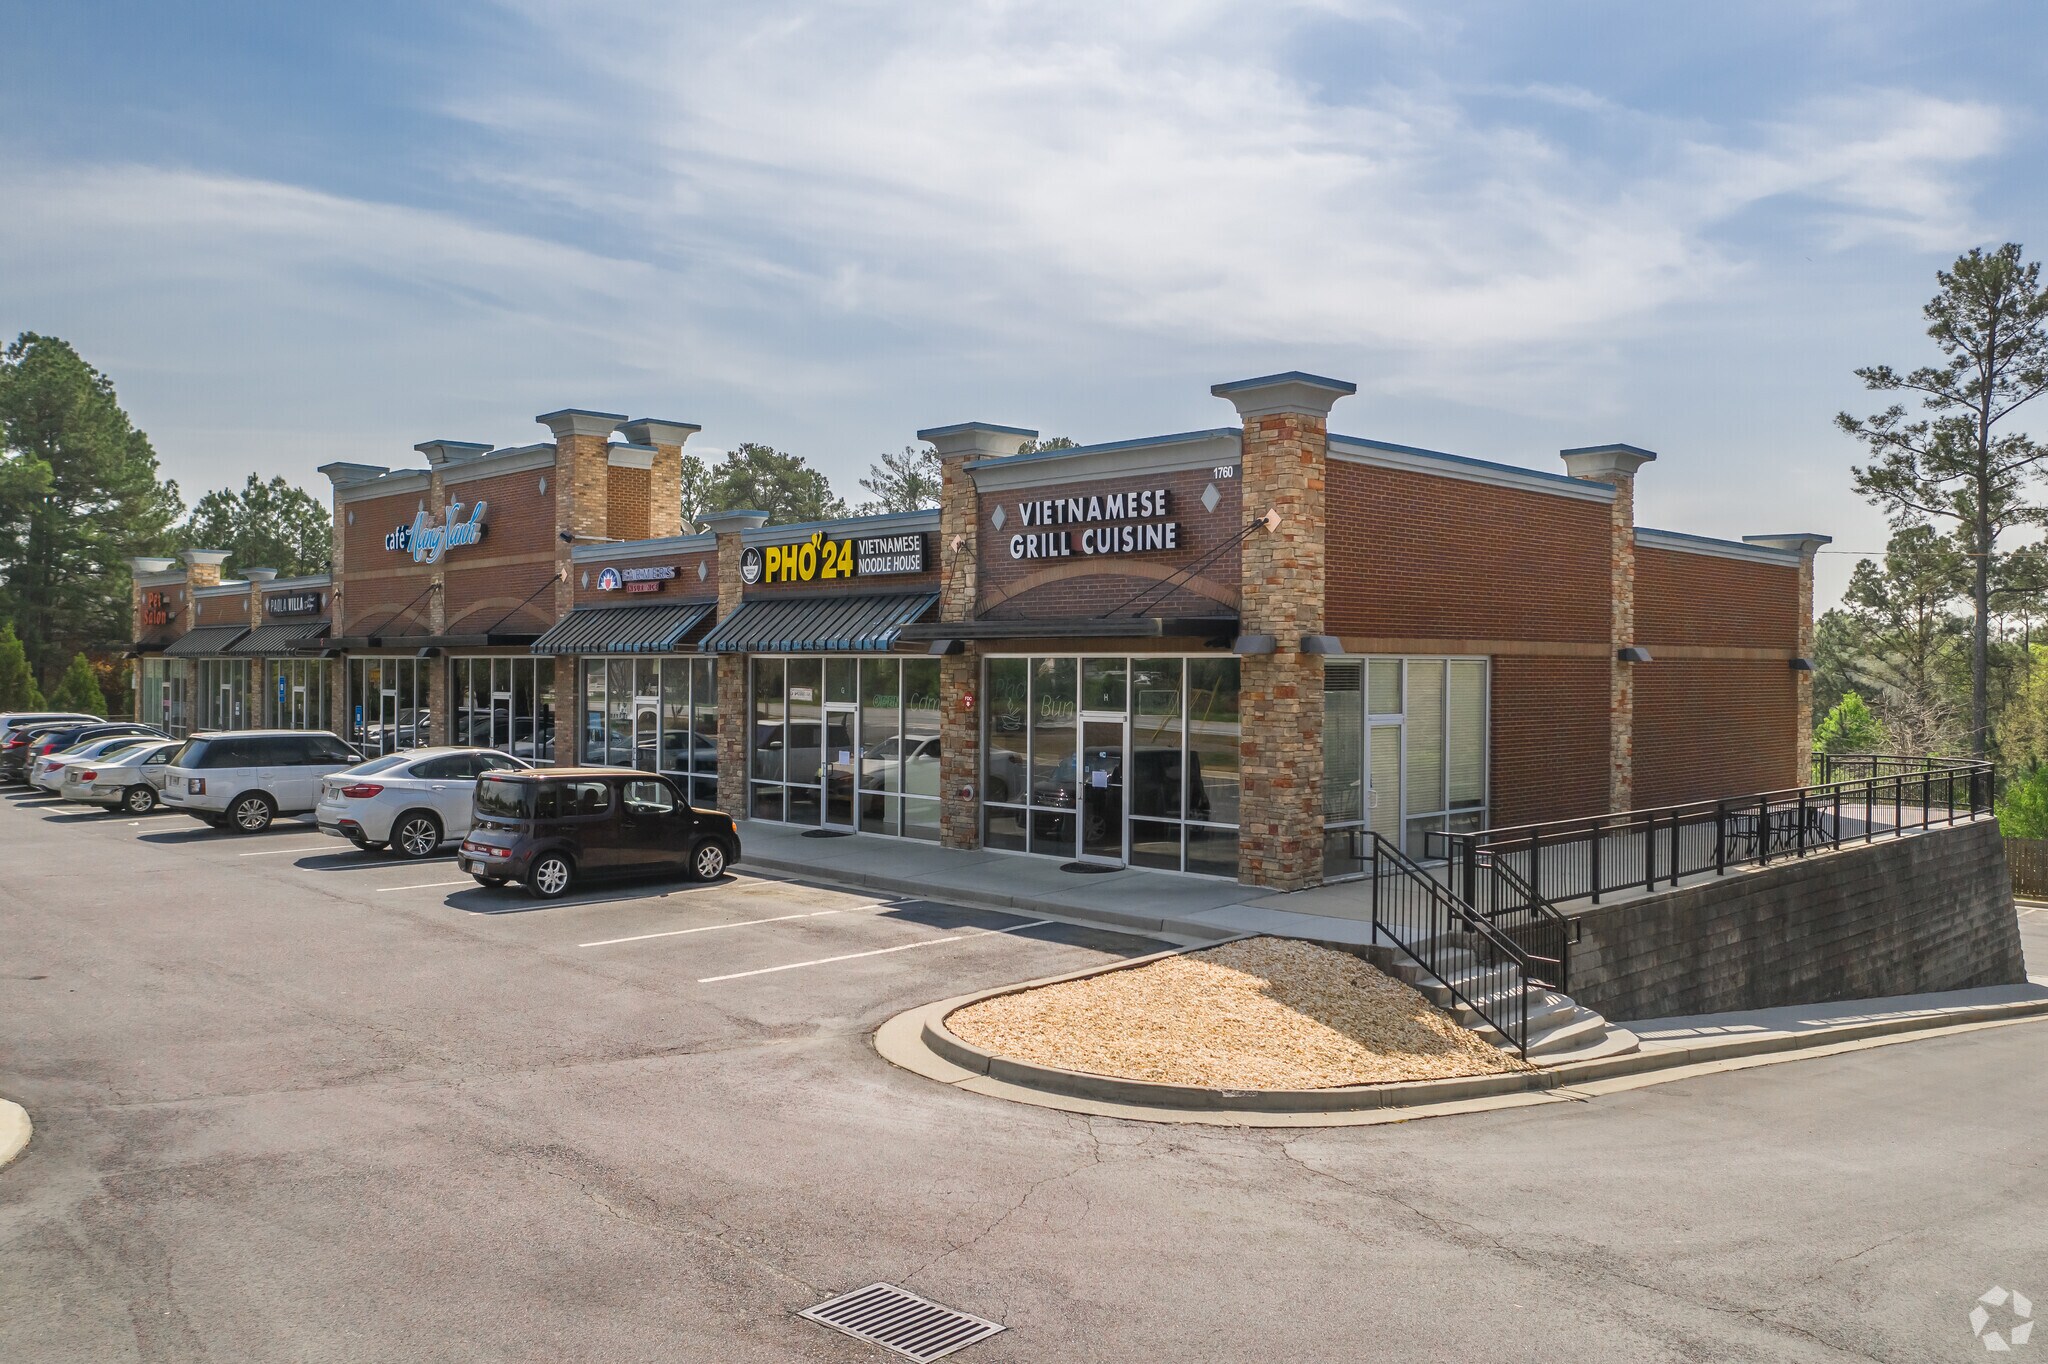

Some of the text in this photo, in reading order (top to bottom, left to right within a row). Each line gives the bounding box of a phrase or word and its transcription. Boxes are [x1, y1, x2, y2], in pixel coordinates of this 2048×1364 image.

[1213, 465, 1233, 479] 1760
[1019, 489, 1166, 526] VIETNAMESE
[385, 525, 405, 551] café
[858, 535, 920, 555] VIETNAMESE
[1010, 523, 1176, 559] GRILL CUISINE
[821, 539, 853, 579] 24
[858, 554, 920, 574] NOODLE HOUSE
[622, 566, 675, 581] FARMERS
[627, 582, 659, 593] INSURNC
[147, 592, 161, 608] Pet
[270, 598, 287, 612] PAOLA
[288, 597, 304, 611] VILLA
[144, 609, 167, 625] Salon
[872, 694, 898, 708] OPEN
[1103, 693, 1109, 702] H
